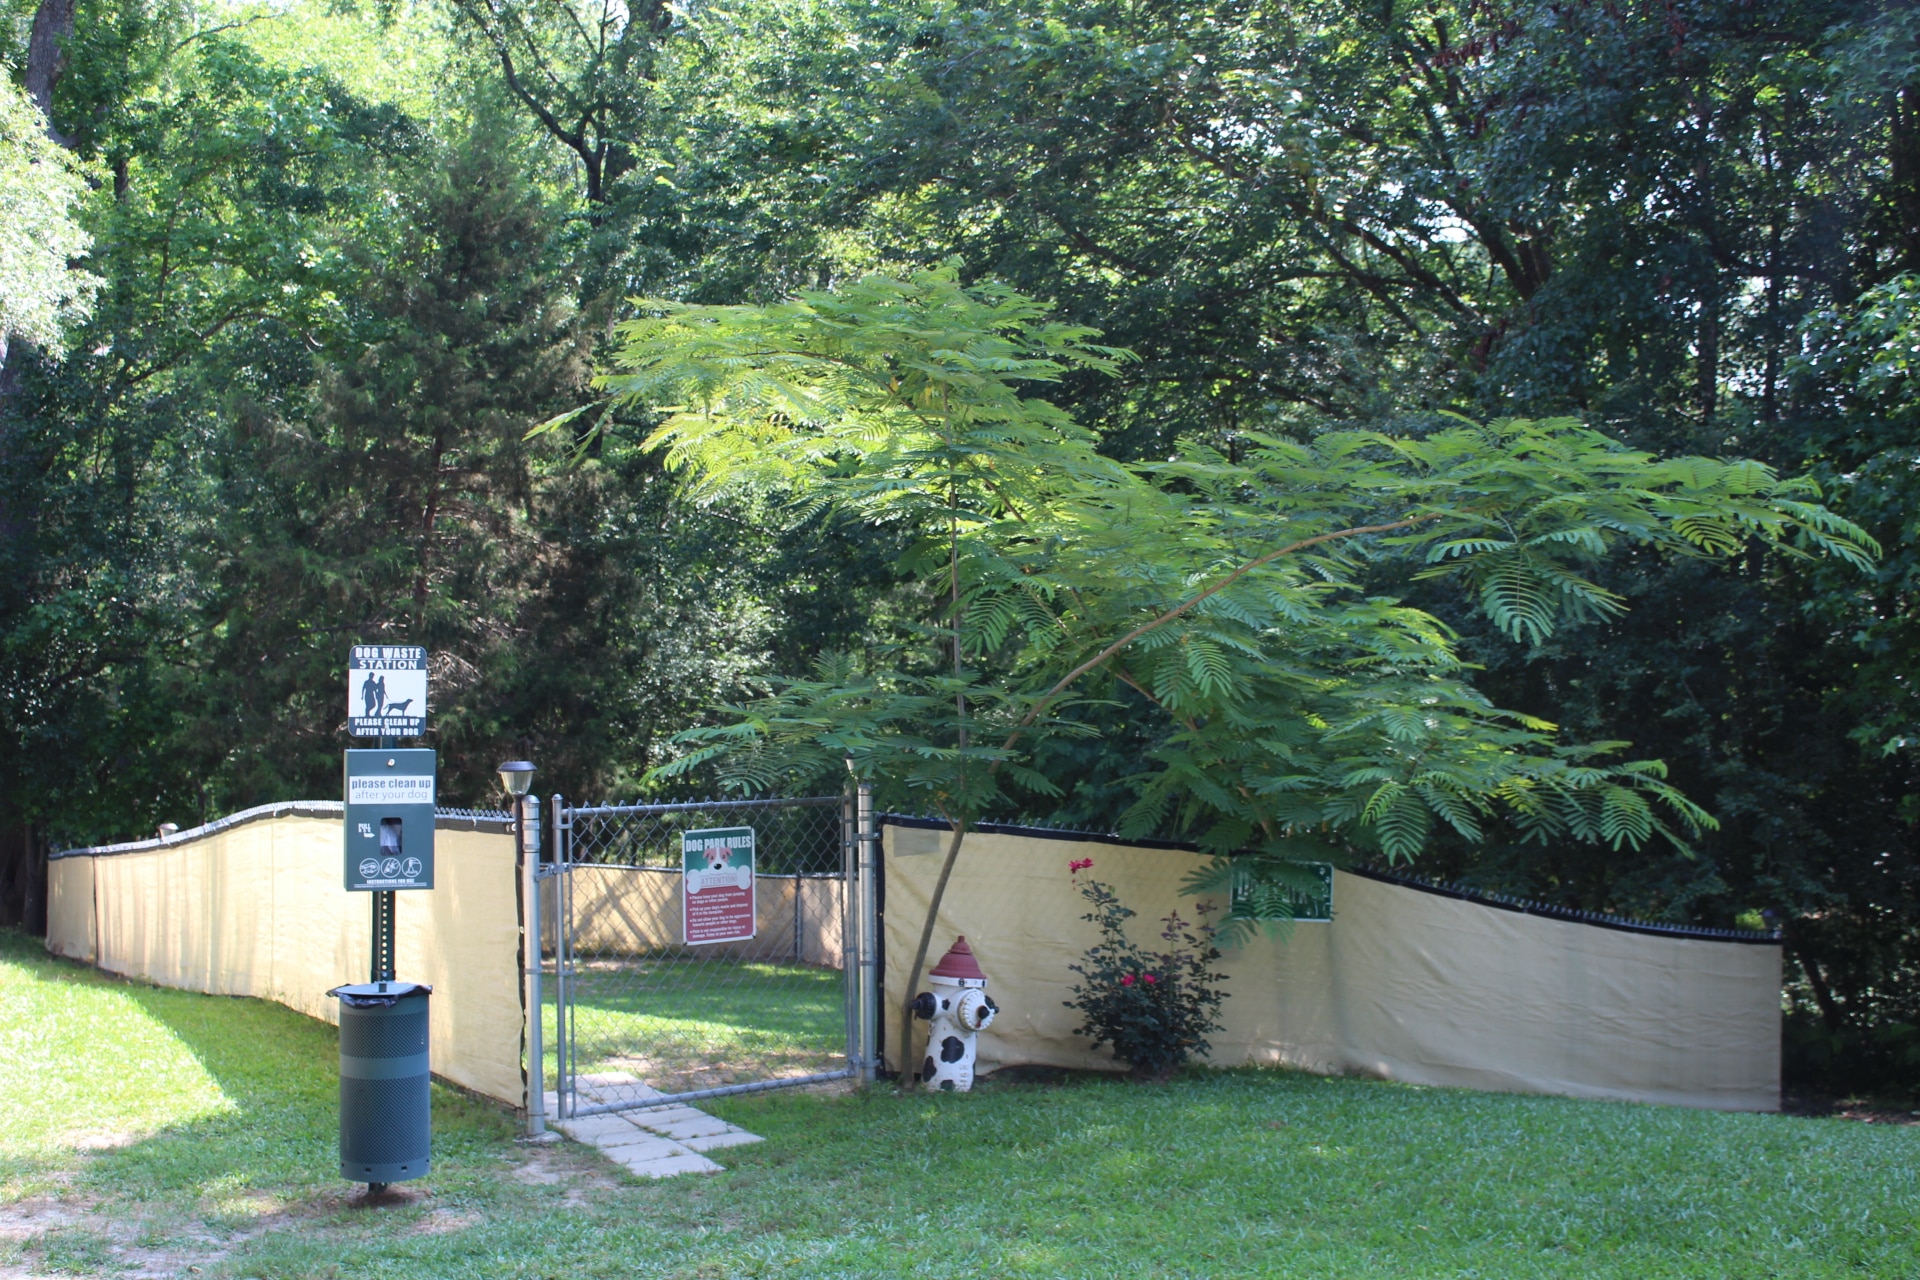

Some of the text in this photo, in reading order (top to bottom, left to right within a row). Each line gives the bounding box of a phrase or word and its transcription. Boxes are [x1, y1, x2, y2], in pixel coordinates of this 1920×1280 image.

[355, 647, 421, 659] DOG WASTE
[360, 660, 417, 669] STATION
[384, 718, 408, 726] CLEAN
[352, 779, 431, 789] please clean up
[355, 790, 428, 801] after your dog
[686, 836, 751, 852] DOG PARK RULES
